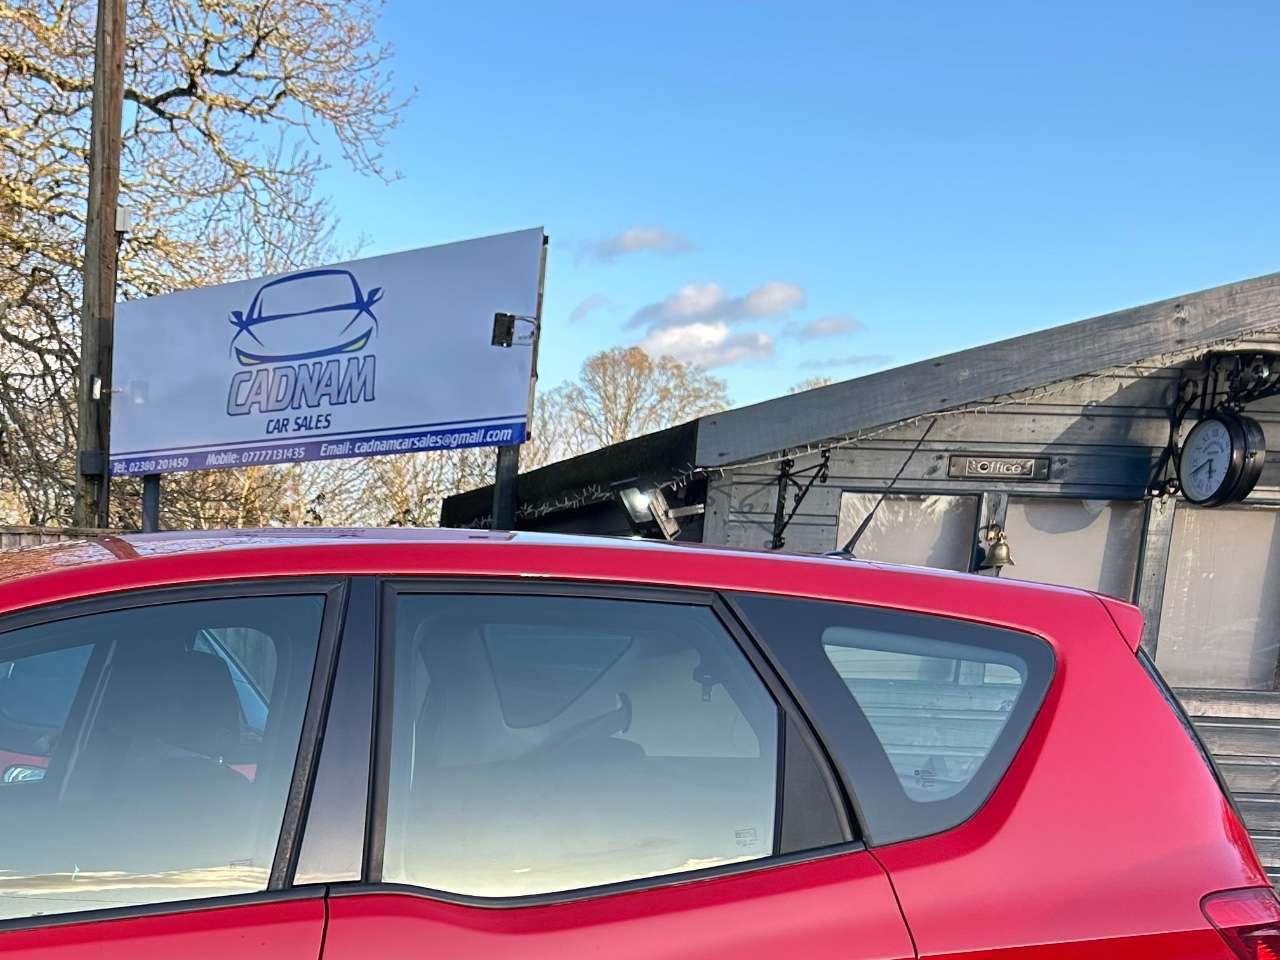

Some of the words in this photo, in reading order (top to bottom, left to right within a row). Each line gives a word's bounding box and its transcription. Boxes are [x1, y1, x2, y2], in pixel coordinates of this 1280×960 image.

[227, 355, 376, 416] CADNAM
[266, 418, 289, 434] CAR
[292, 413, 332, 432] SALES
[206, 451, 240, 466] Mobile:
[241, 447, 306, 463] 07777131435
[320, 441, 352, 457] Email:
[354, 428, 512, 454] cadnamcarsales@gmail.com
[977, 461, 1022, 474] Office
